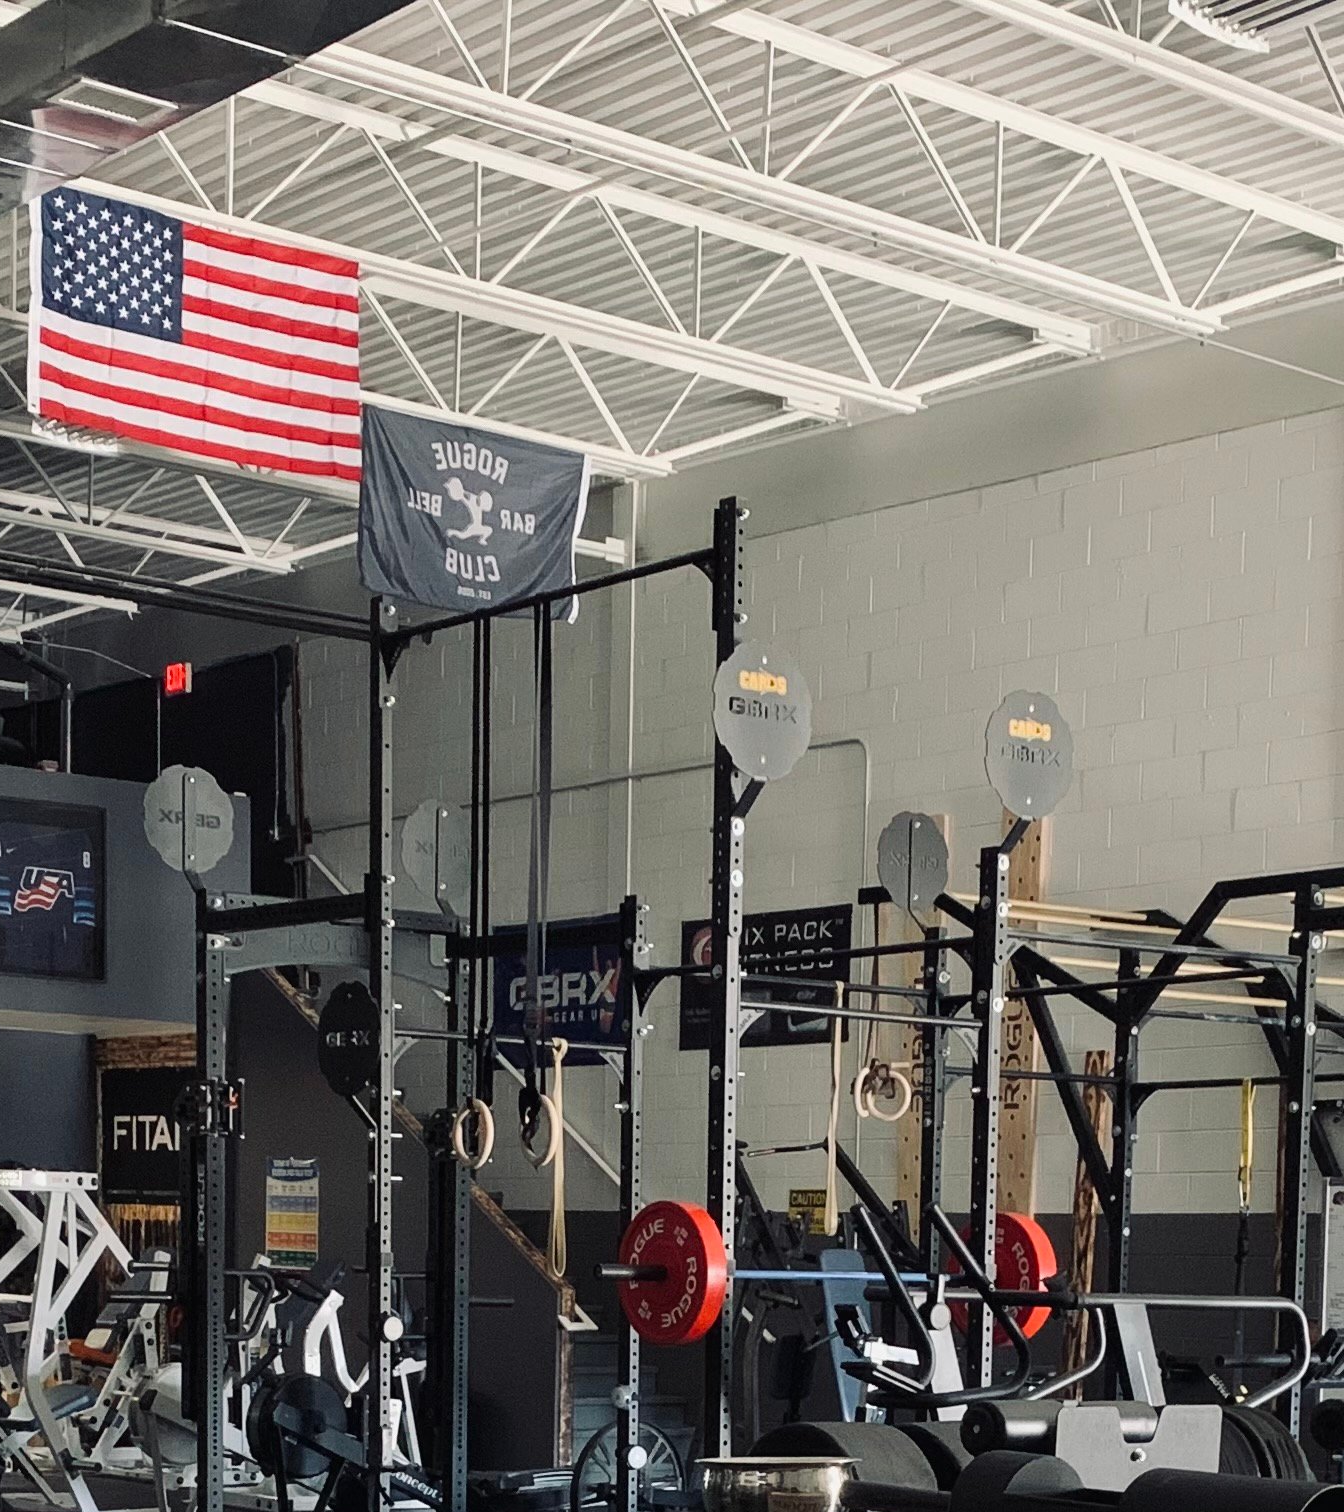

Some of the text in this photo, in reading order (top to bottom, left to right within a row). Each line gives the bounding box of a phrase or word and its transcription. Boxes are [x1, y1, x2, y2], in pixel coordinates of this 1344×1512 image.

[738, 926, 766, 947] IX
[773, 918, 834, 943] PACK
[112, 1115, 181, 1151] FITAI
[660, 1256, 697, 1328] ROGUE
